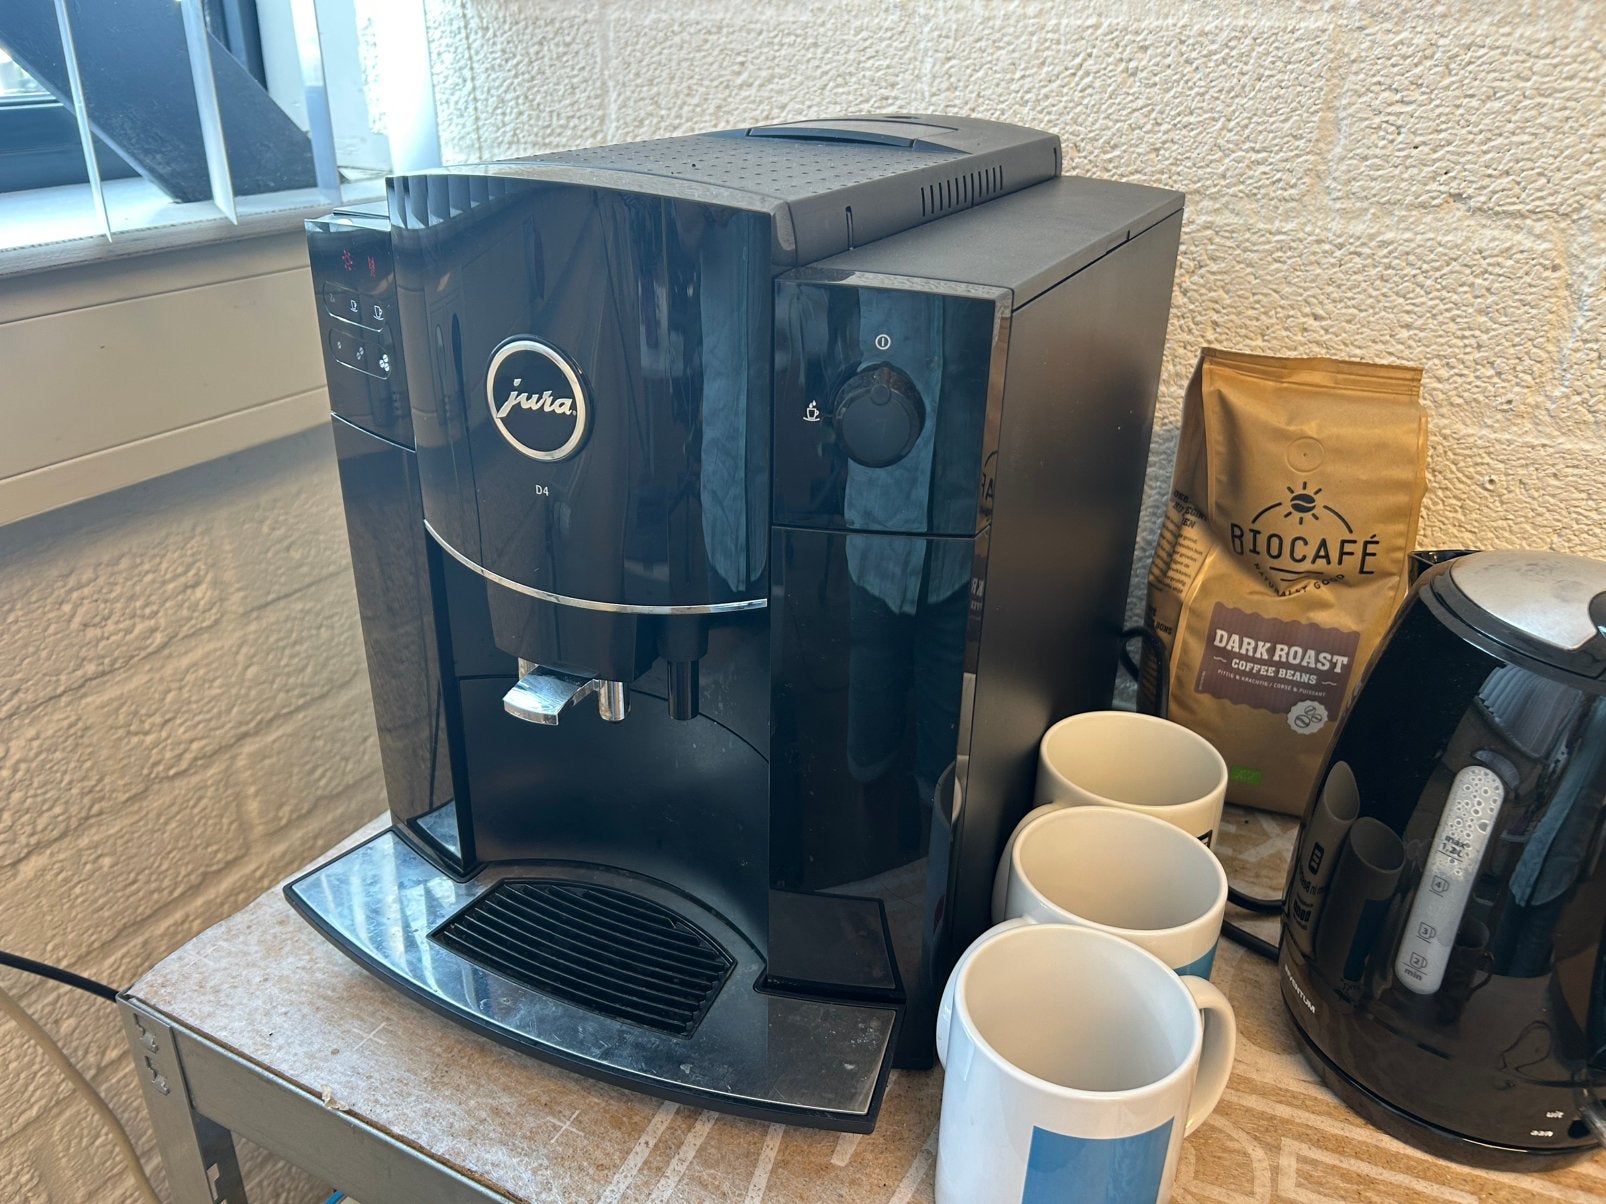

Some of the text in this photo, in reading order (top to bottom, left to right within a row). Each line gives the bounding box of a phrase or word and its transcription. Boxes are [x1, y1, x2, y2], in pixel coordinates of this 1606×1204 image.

[496, 378, 574, 419] jura
[535, 484, 549, 497] D4
[1230, 522, 1380, 575] BIOCAFÉ
[1313, 573, 1346, 590] GOOD
[1213, 628, 1350, 674] DARK ROAST
[1231, 658, 1318, 685] COFFEE BEANS
[1444, 834, 1467, 850] max
[1404, 967, 1423, 982] min
